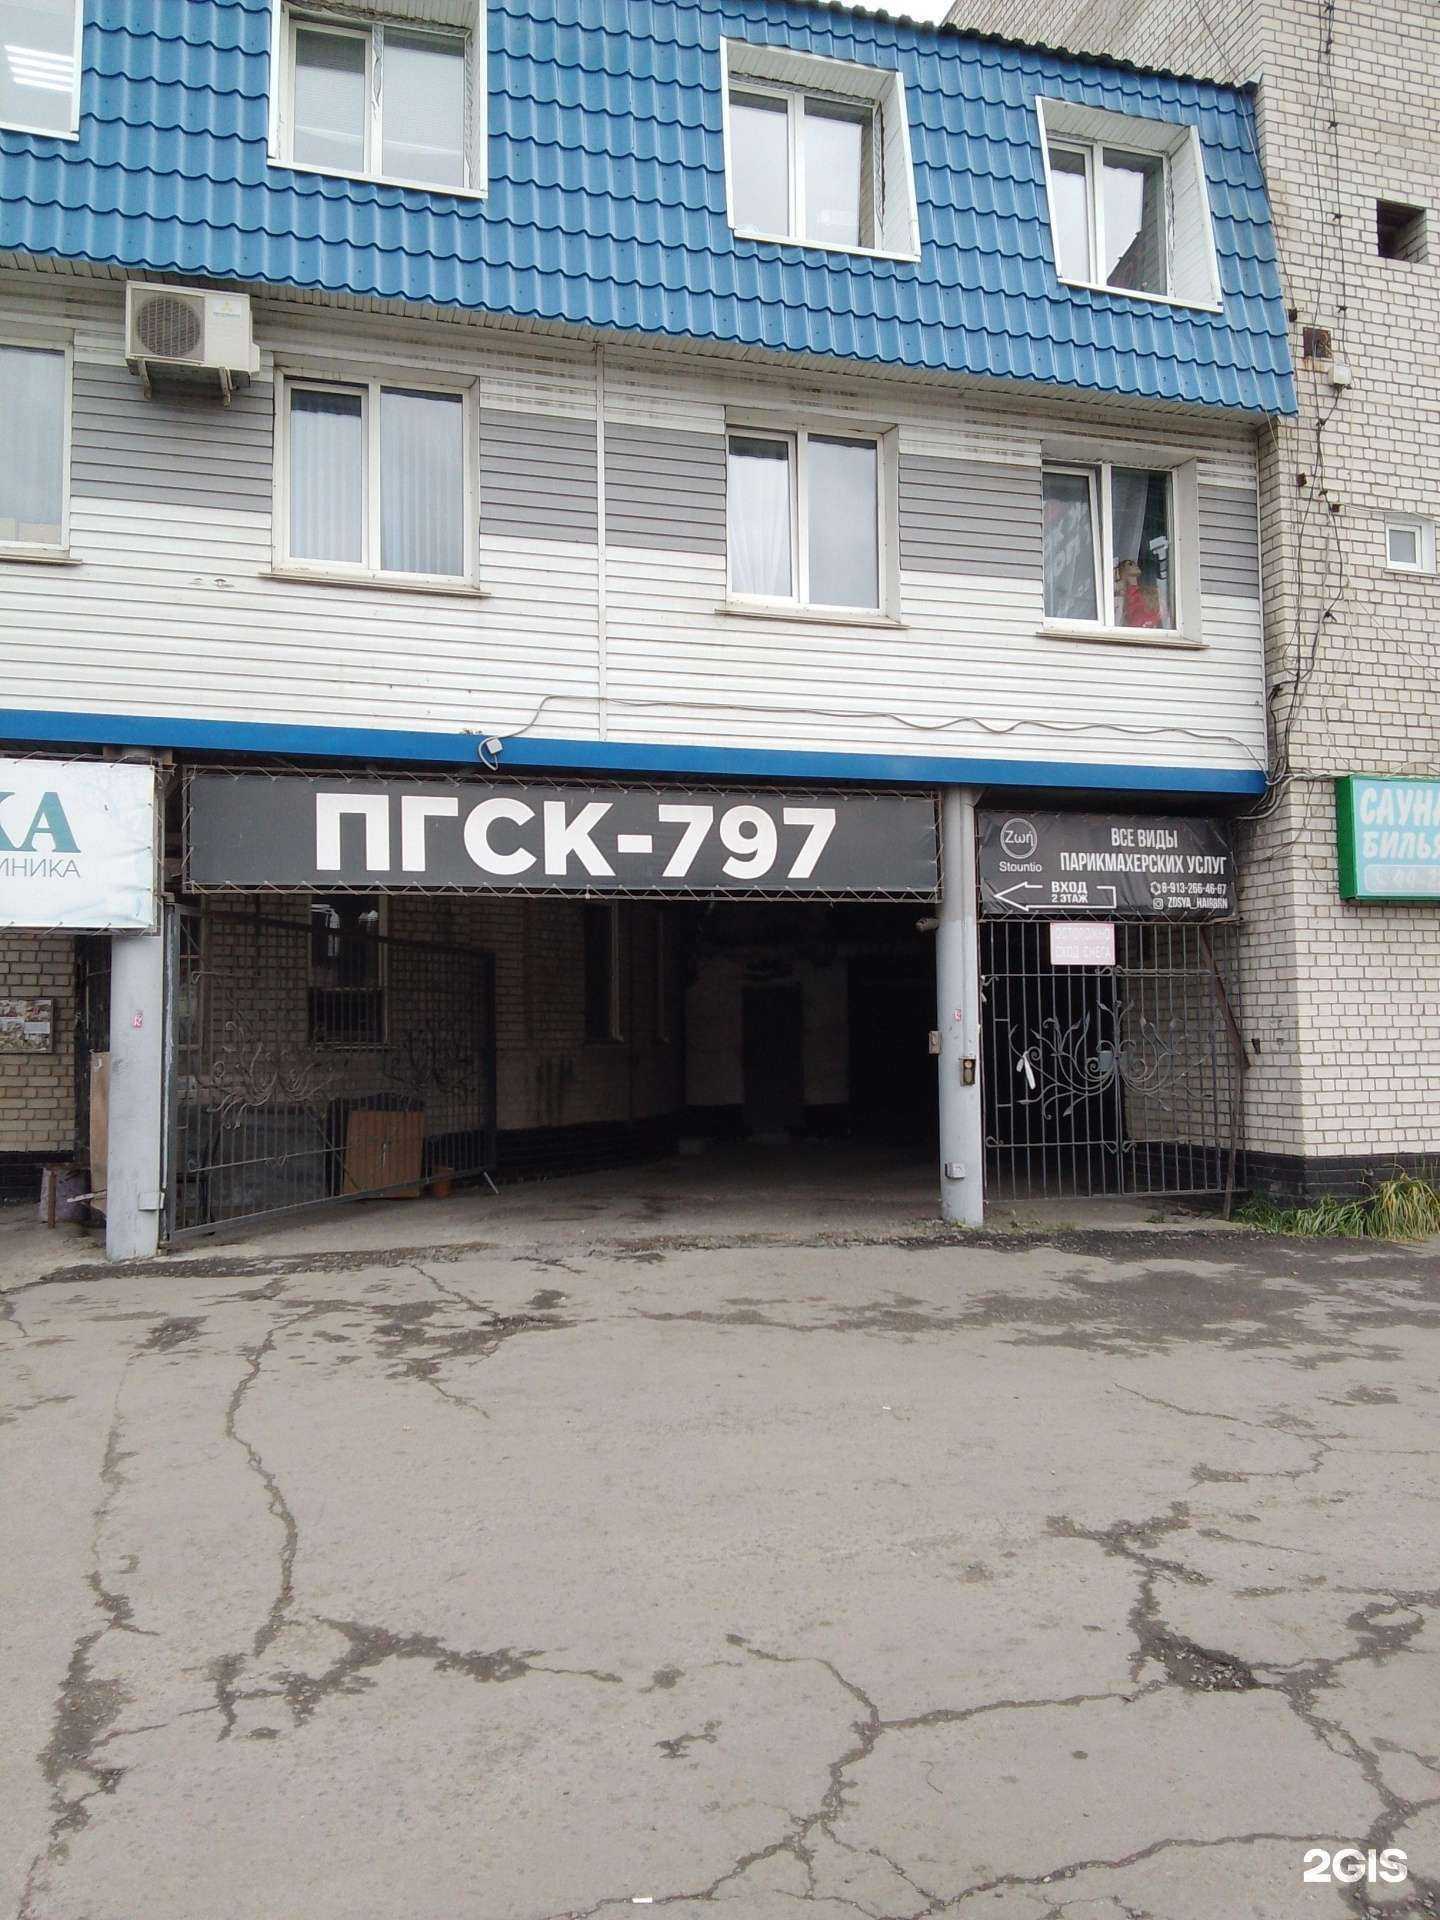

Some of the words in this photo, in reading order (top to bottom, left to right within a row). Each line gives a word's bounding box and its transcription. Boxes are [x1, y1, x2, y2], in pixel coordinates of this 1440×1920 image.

[316, 792, 836, 880] ПГСК-797
[1111, 827, 1134, 847] ВСЕ
[1138, 829, 1178, 850] ВИДЫ
[1060, 852, 1183, 873] ПАРИКМАХЕРСКИХ
[1186, 856, 1227, 875] УСЛУГ
[1051, 881, 1087, 894] ВХОД
[1060, 894, 1088, 903] ЭТАЖ
